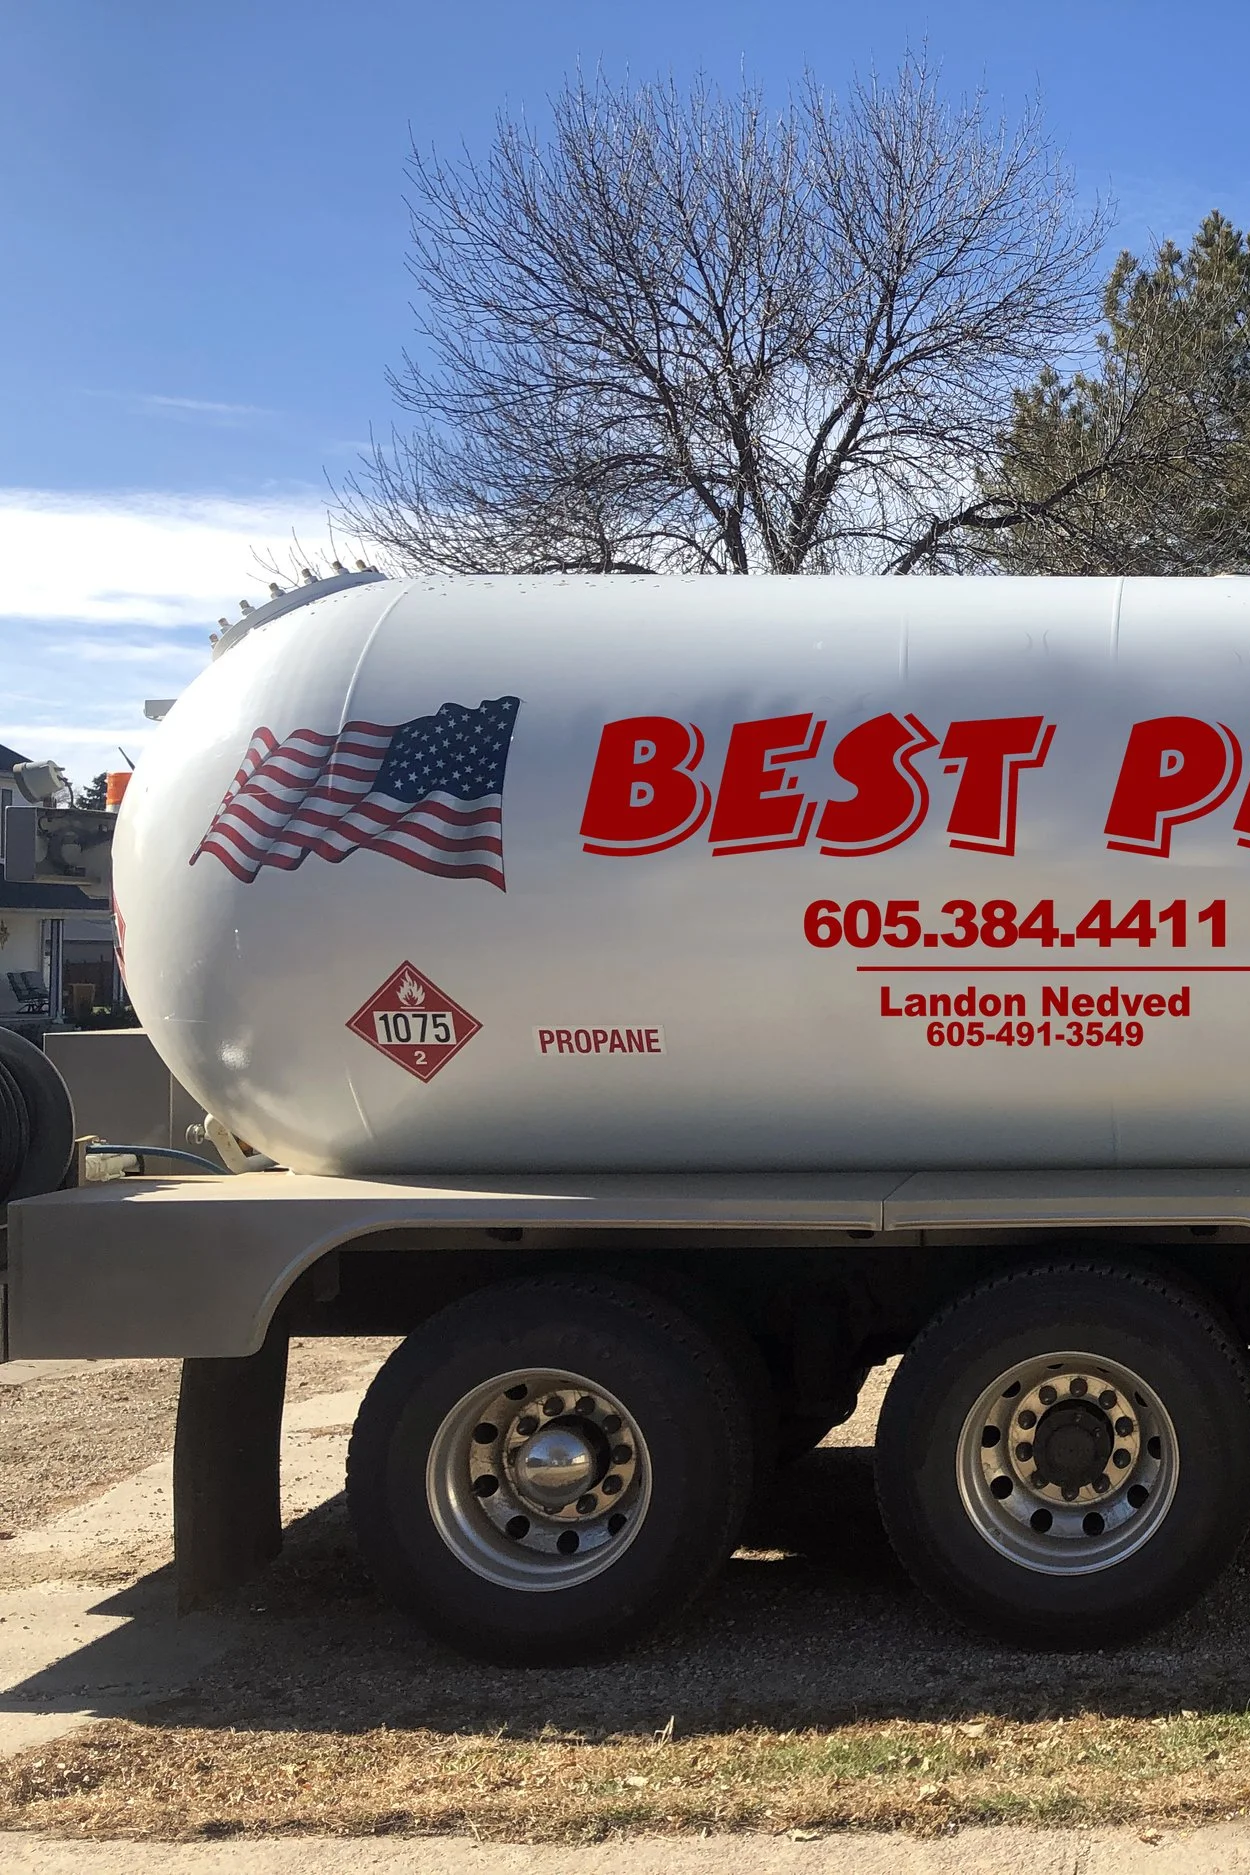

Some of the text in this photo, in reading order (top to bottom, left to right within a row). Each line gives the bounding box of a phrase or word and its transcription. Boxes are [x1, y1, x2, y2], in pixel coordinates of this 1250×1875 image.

[580, 713, 1056, 857] BEST
[804, 899, 1226, 948] 605.384.4411
[881, 986, 1190, 1017] Landon Nedved
[378, 1012, 451, 1044] 1075
[538, 1028, 662, 1054] PROPANE
[927, 1021, 1144, 1047] 605-491-3549
[413, 1050, 428, 1065] 2
